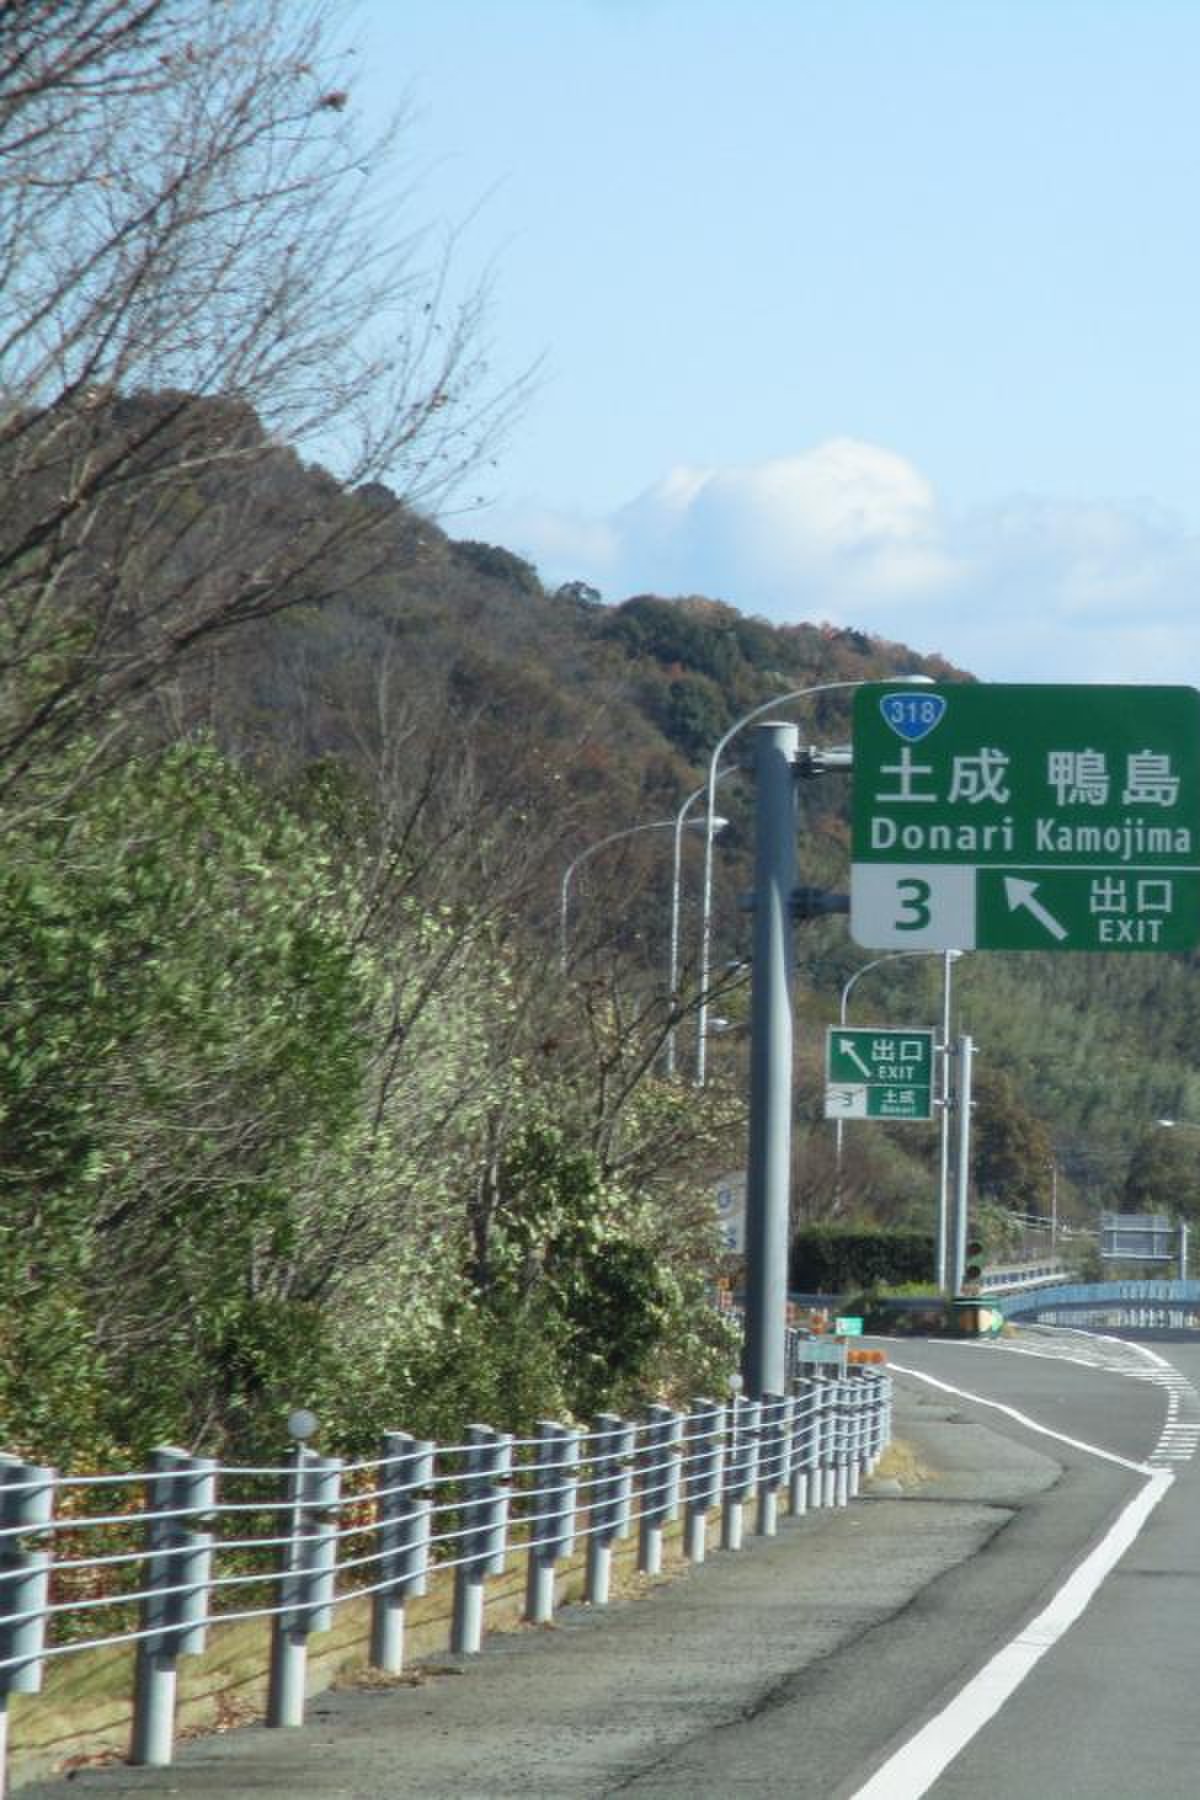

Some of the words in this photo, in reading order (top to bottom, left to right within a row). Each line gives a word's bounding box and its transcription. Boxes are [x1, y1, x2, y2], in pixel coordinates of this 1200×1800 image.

[890, 701, 936, 723] 318
[875, 747, 1010, 803] 土成
[1047, 749, 1180, 806] 鴨島
[871, 816, 1014, 849] Donari
[1036, 818, 1191, 860] Kamojima
[894, 878, 931, 931] 3
[1089, 876, 1173, 913] 出口
[1099, 919, 1163, 942] EXIT
[871, 1039, 922, 1061] 出口
[879, 1066, 914, 1079] EXIT
